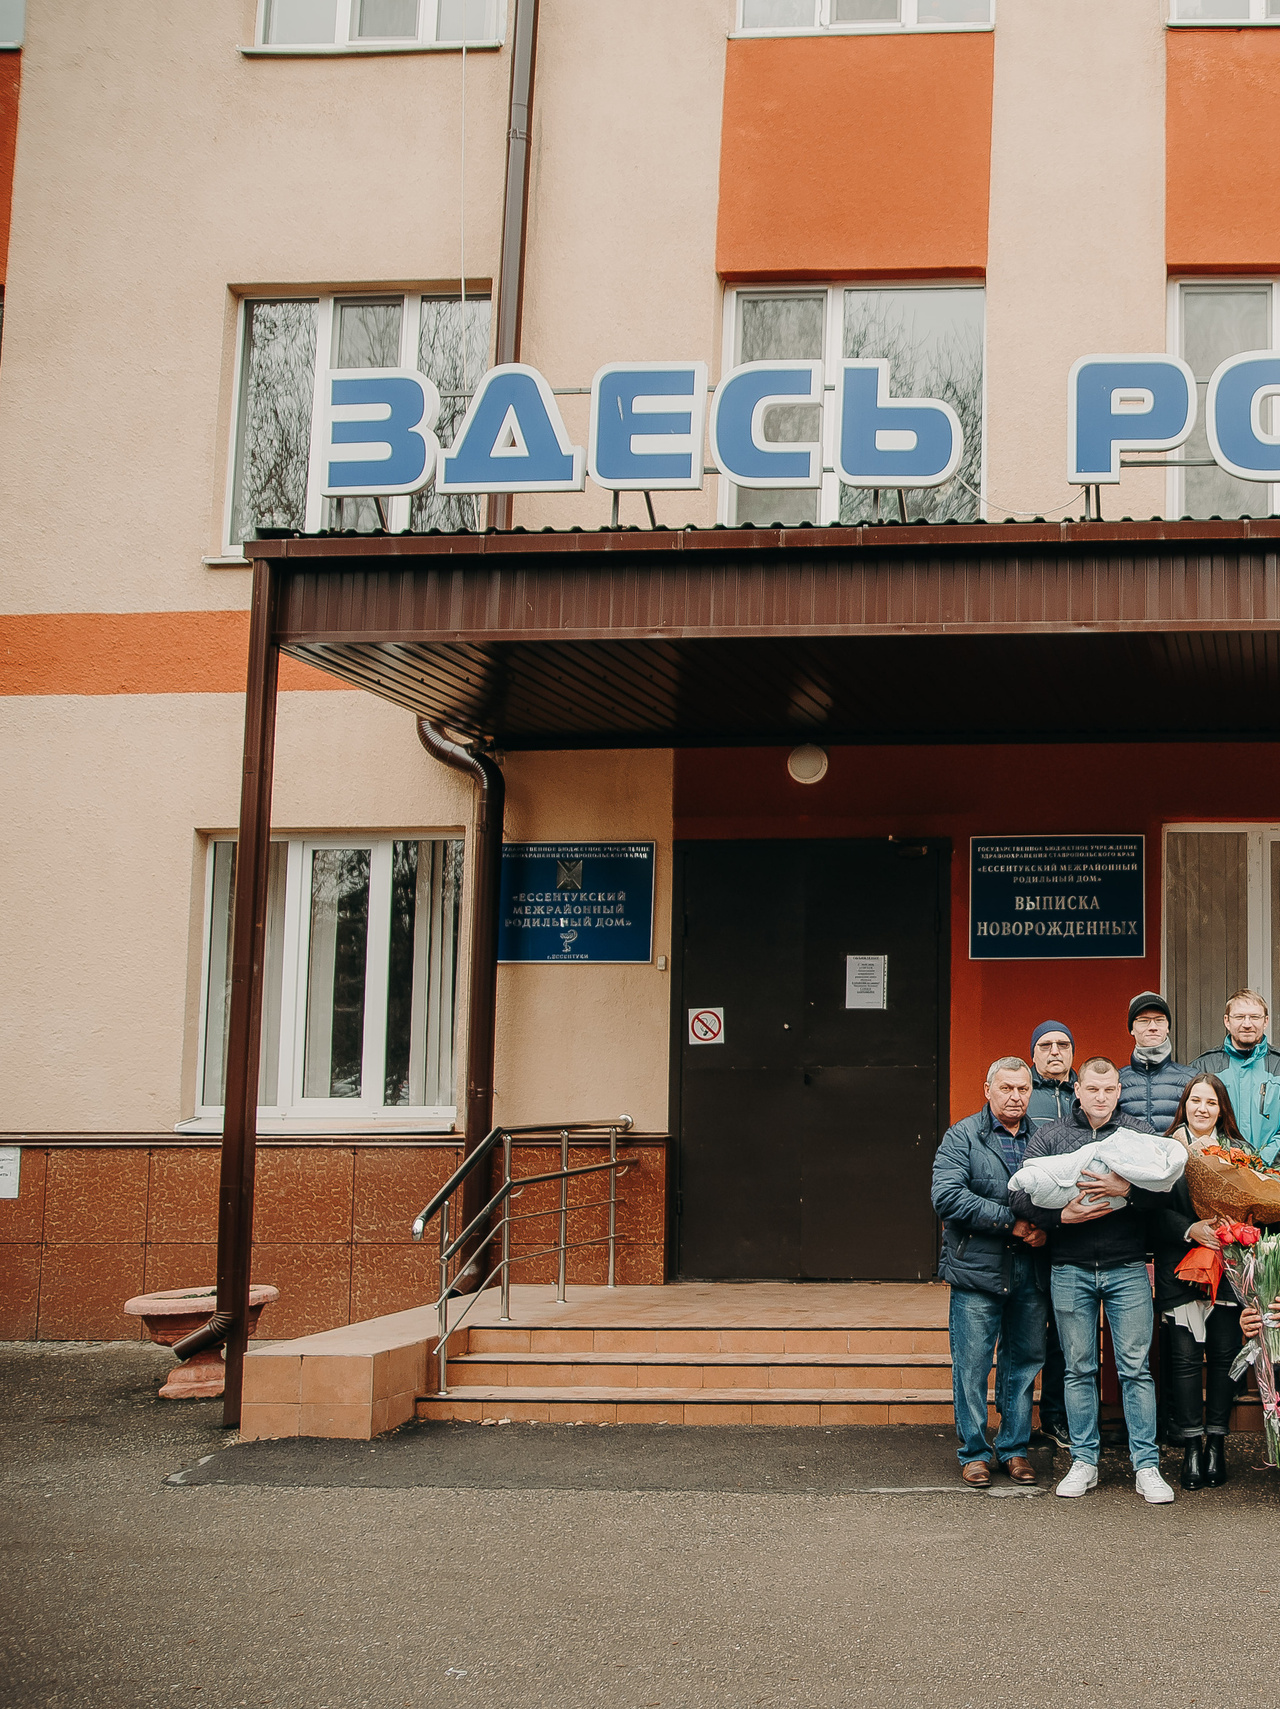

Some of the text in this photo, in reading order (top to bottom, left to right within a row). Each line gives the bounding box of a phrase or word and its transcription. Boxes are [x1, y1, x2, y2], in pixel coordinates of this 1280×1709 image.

[322, 359, 962, 495] ЗДЕСЬ
[977, 862, 1138, 873] «ЕССЕНТУКСКИЙ МЕЖРАЙОННЫЙ
[1013, 874, 1102, 884] РОДИЛЬНЫЙ ДОМ»
[512, 891, 627, 902] «ЕССЕНТУКСКИЙ
[1014, 895, 1100, 911] ВЫПИСКА
[513, 904, 625, 915] МЕЖРАЙОННЫЙ
[505, 916, 632, 928] РОДИЛЬНЫЙ ДОМ»
[976, 920, 1138, 938] НОВОРОЖДЕННЫХ
